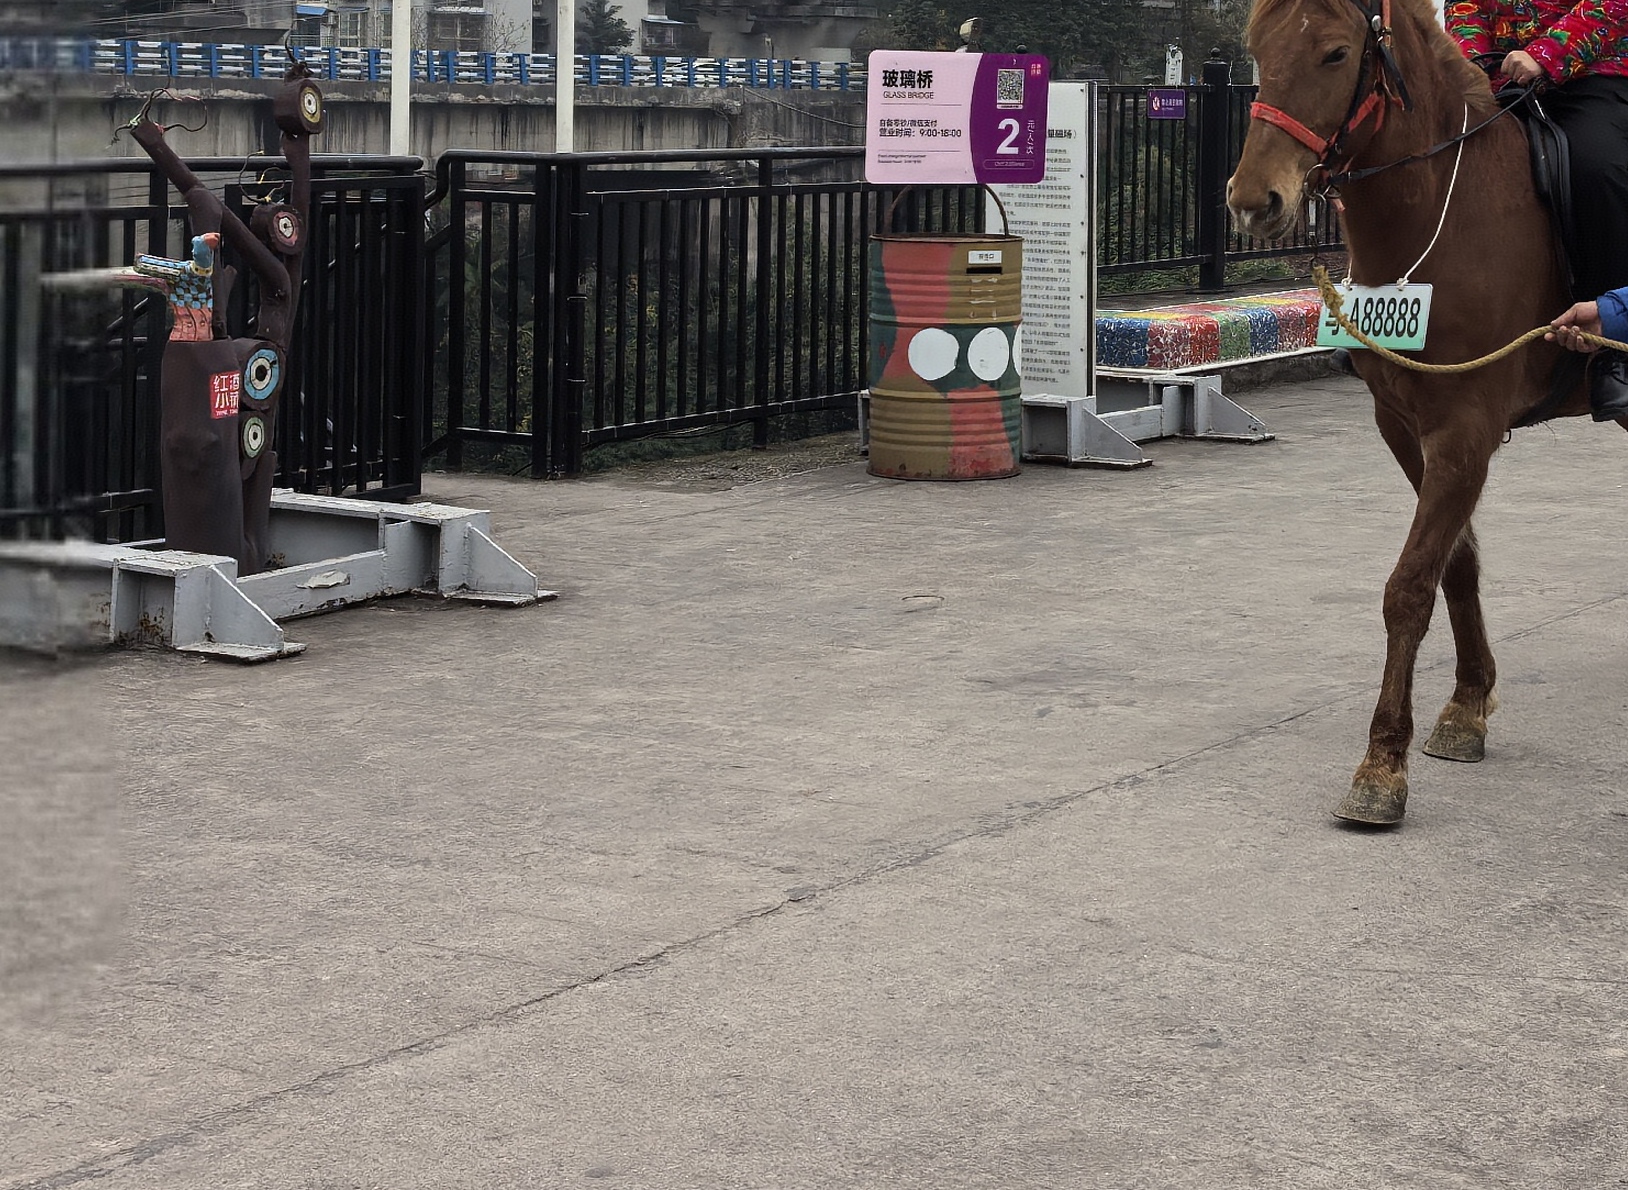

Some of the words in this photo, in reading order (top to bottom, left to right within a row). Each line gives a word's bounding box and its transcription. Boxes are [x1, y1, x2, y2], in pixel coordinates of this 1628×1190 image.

[882, 69, 933, 89] 玻璃桥
[883, 91, 906, 99] GLASS
[907, 91, 934, 99] BRIDGE
[996, 118, 1020, 155] 2
